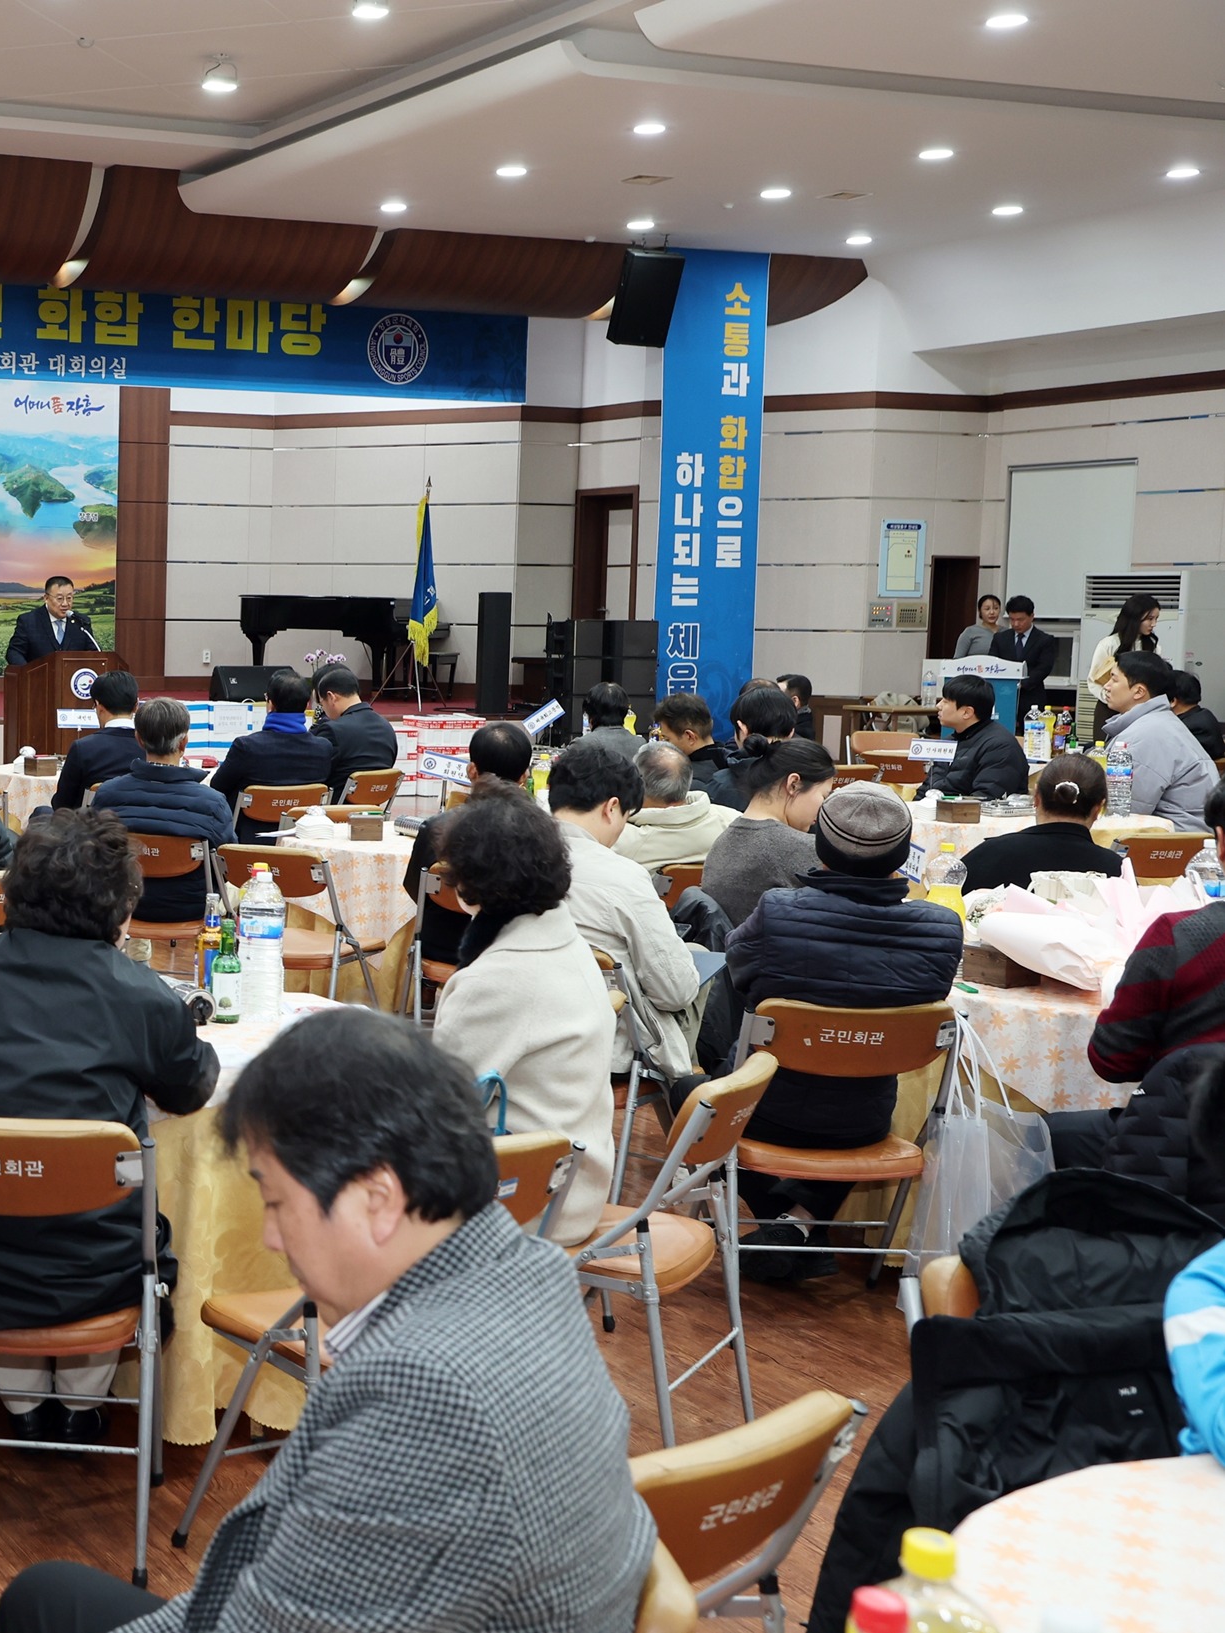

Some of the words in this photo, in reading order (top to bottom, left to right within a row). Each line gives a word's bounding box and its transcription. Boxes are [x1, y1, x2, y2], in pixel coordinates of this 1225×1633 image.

[37, 285, 144, 347] 화합
[172, 296, 327, 356] 한마당
[721, 281, 751, 398] 소통과
[49, 355, 128, 380] 대회의실
[396, 366, 418, 382] SPORTS
[66, 395, 106, 416] 장흥
[715, 415, 749, 568] 화합으로
[670, 452, 705, 607] 하나되는
[271, 799, 301, 807] 군민회관
[1149, 849, 1184, 860] 군민회관
[819, 1028, 886, 1046] 군민회관
